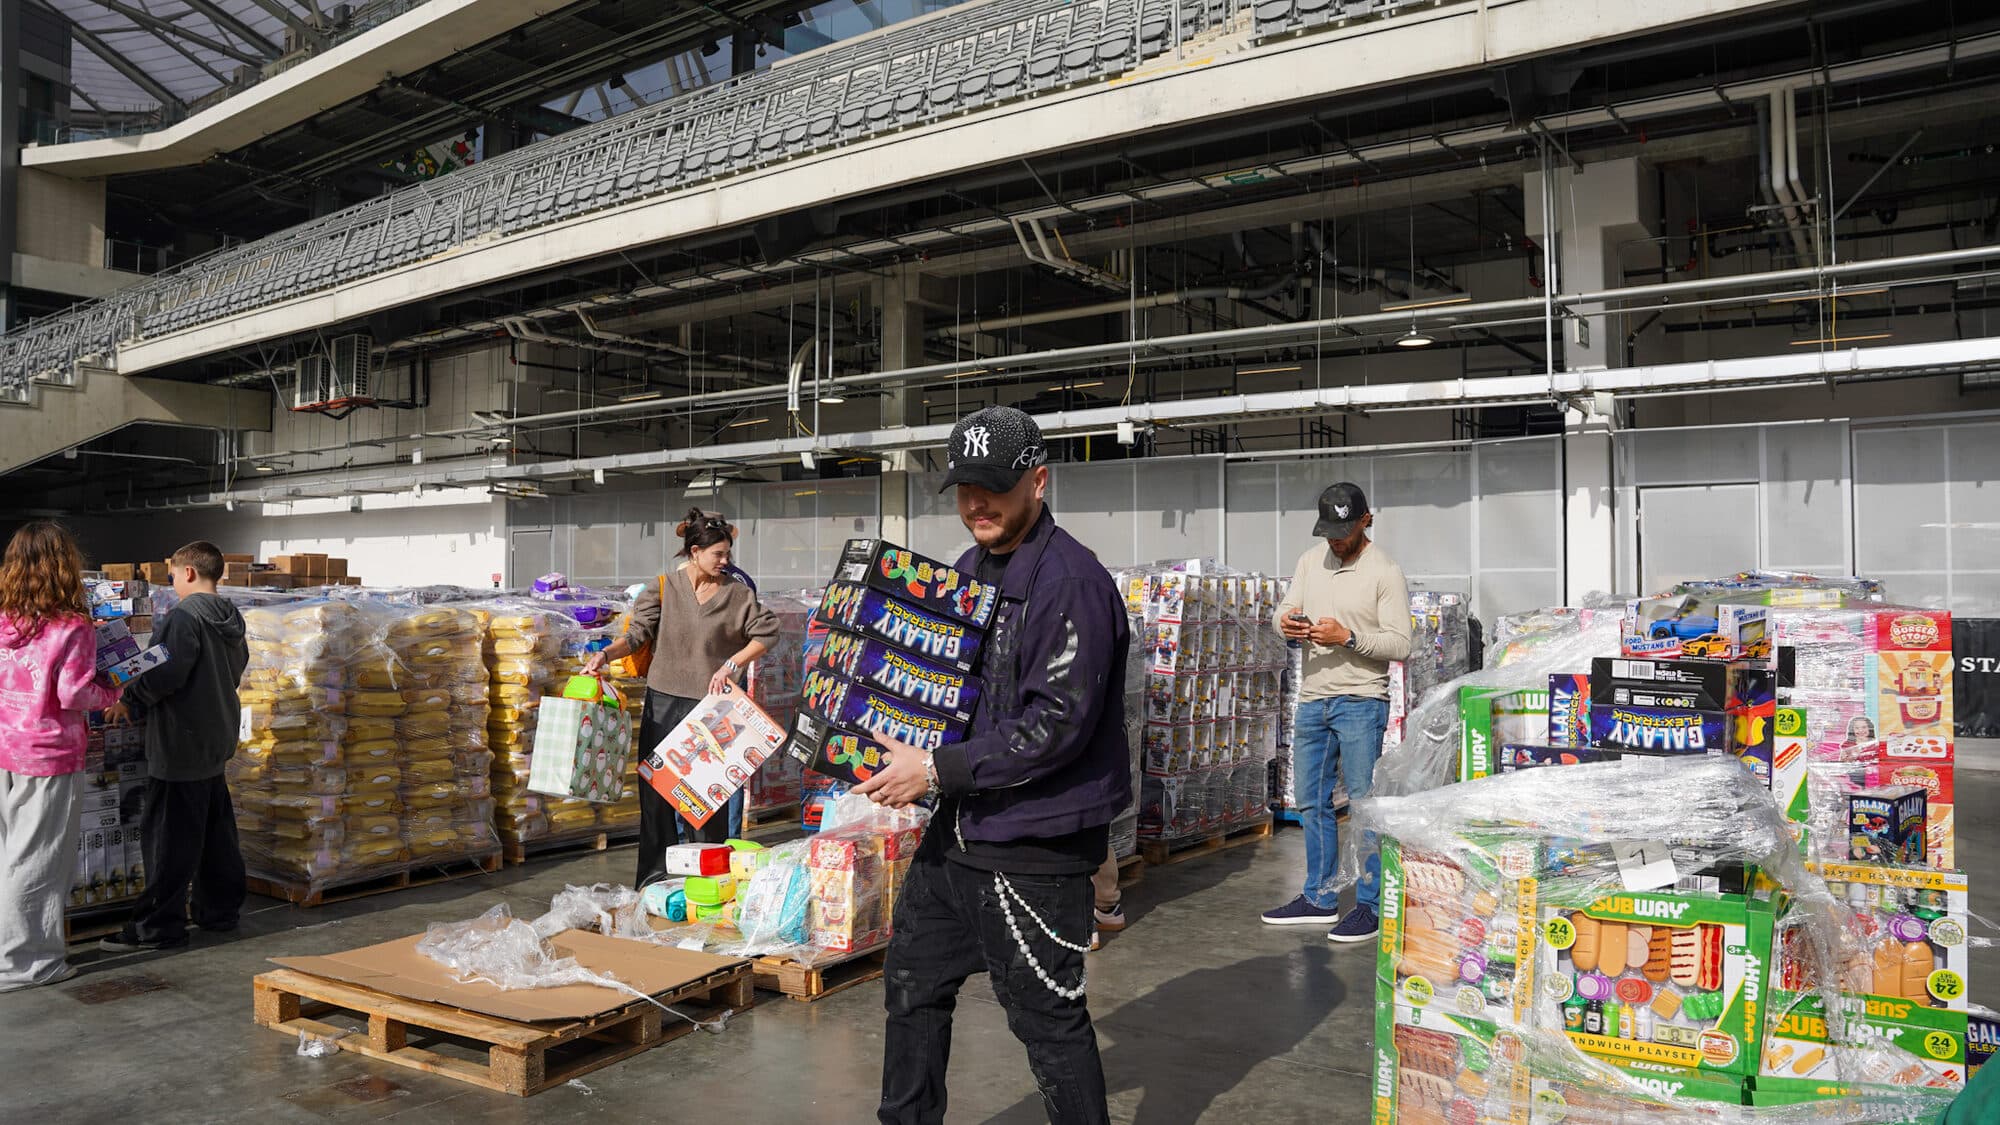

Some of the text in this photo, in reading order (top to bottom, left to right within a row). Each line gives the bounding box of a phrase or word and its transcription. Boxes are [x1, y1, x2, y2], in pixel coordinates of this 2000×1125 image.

[976, 585, 996, 626] GALAXY
[884, 598, 964, 637] FLEX-TRACK
[873, 612, 961, 659] GALAXY
[1892, 625, 1938, 637] BURGER
[1901, 633, 1928, 641] STOP
[1624, 637, 1676, 651] FORD MUSTANG GT
[883, 651, 964, 687] FLEX-TRACK
[873, 662, 960, 708] GALAXY
[867, 694, 947, 731] FLEX-TRACK
[1612, 709, 1704, 727] FLEX-TRACK
[1778, 713, 1795, 723] 24
[855, 708, 944, 751] GALAXY
[1608, 721, 1706, 750] GALAXY
[1852, 800, 1892, 812] GALAXY
[1898, 796, 1924, 824] GALAXY
[1382, 869, 1400, 954] SUBWAY
[1590, 896, 1691, 919] SUBWAY
[1549, 923, 1569, 936] 24
[1728, 946, 1741, 954] 3+
[1743, 948, 1761, 1044] SUBWAY
[1934, 983, 1958, 995] 24
[1930, 1036, 1951, 1048] 24
[1638, 1046, 1697, 1062] PLAYSET
